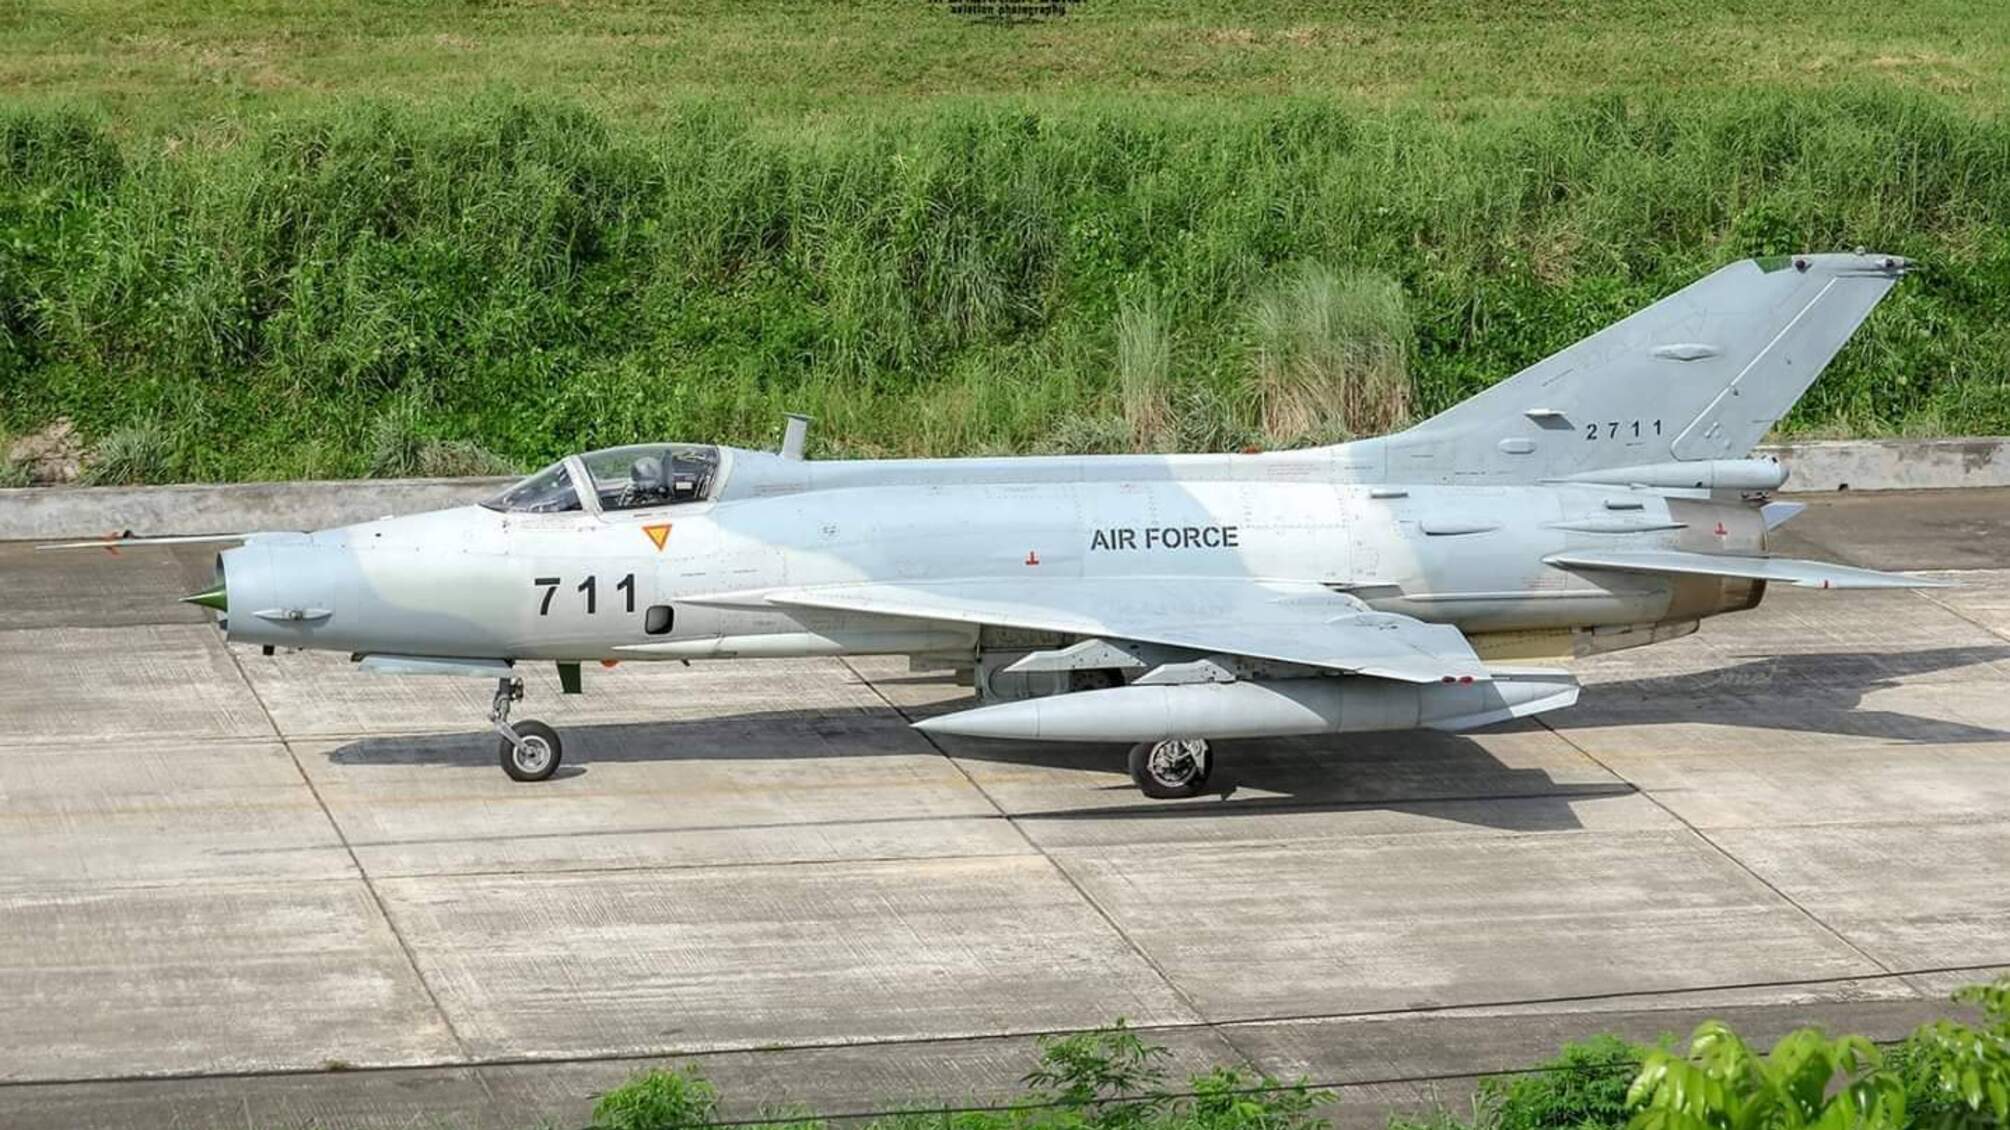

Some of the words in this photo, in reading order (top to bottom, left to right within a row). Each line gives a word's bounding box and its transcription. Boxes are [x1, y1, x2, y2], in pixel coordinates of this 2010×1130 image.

[1586, 419, 1664, 441] 2711
[1090, 528, 1137, 551] AIR
[1145, 526, 1240, 549] FORCE
[534, 573, 635, 616] 711
